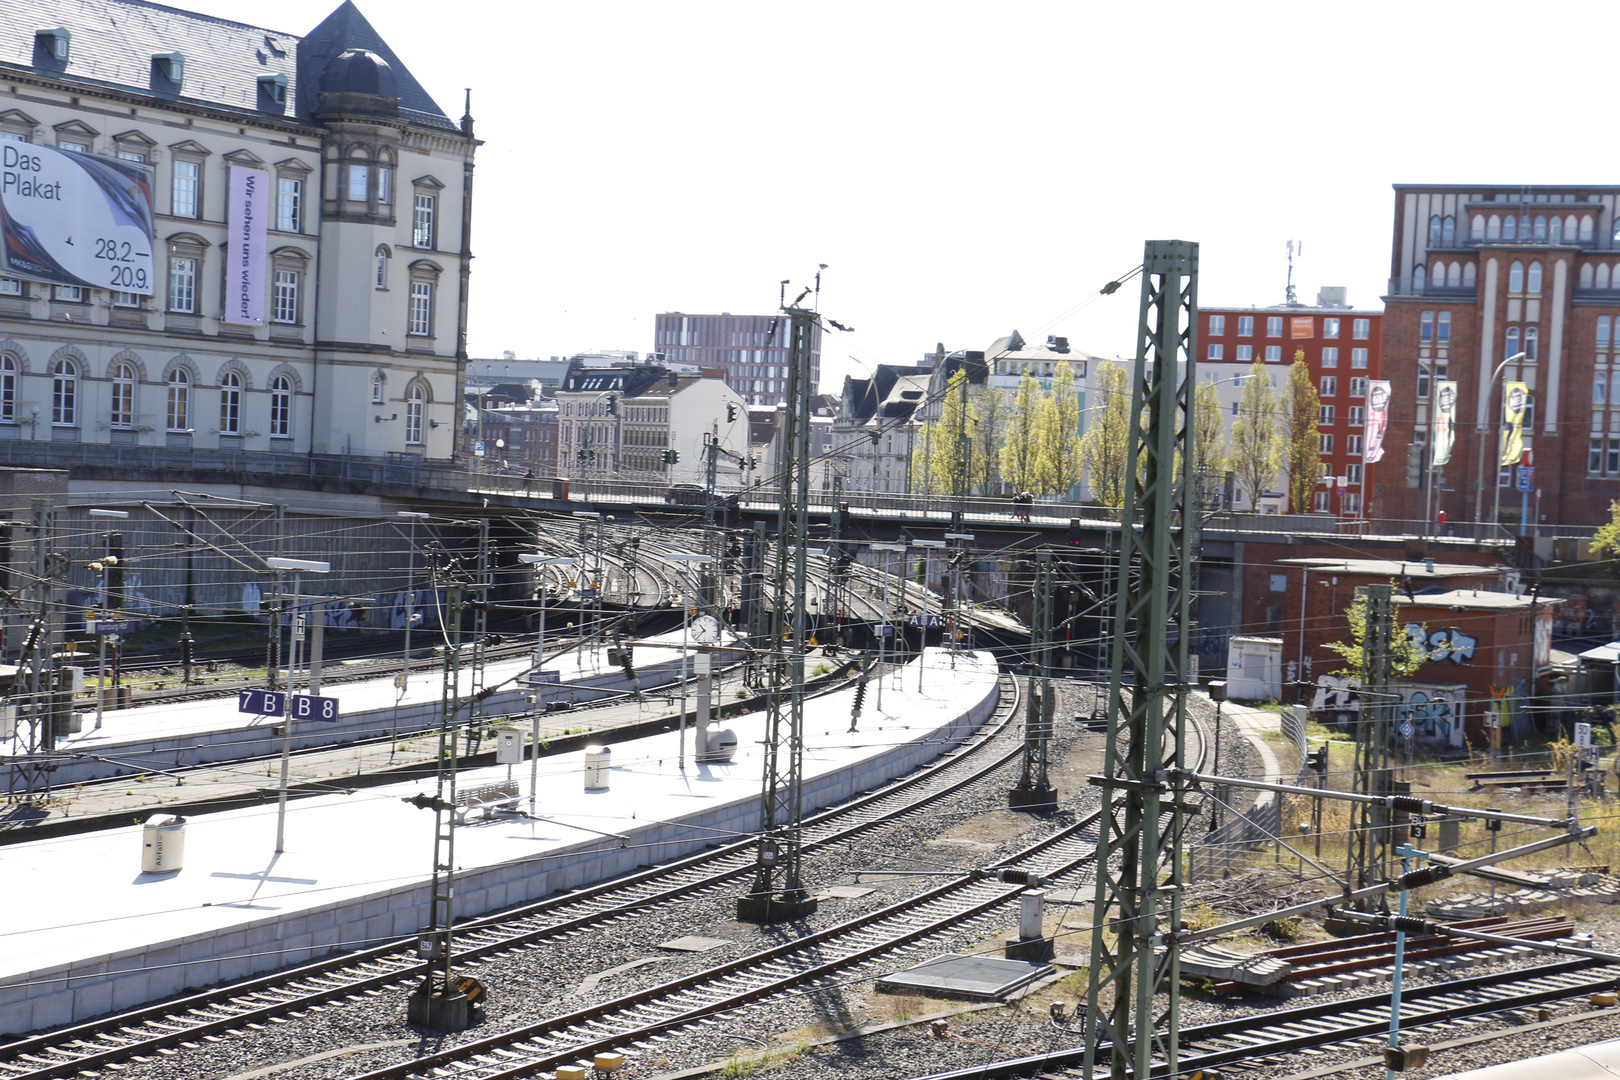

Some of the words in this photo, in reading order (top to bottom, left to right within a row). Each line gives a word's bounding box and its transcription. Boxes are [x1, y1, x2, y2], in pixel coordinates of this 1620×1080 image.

[4, 145, 41, 172] Das
[3, 171, 61, 201] Plakat
[245, 175, 255, 199] Wir
[243, 200, 253, 241] sehen
[242, 243, 250, 268] uns
[110, 265, 149, 289] 20.9.
[241, 269, 251, 319] wieder!
[297, 619, 304, 634] H
[910, 616, 918, 625] A
[930, 616, 938, 626] A
[242, 691, 253, 710] 7
[263, 694, 276, 713] B
[298, 697, 311, 716] B
[322, 700, 333, 719] 8
[1414, 827, 1421, 838] 3
